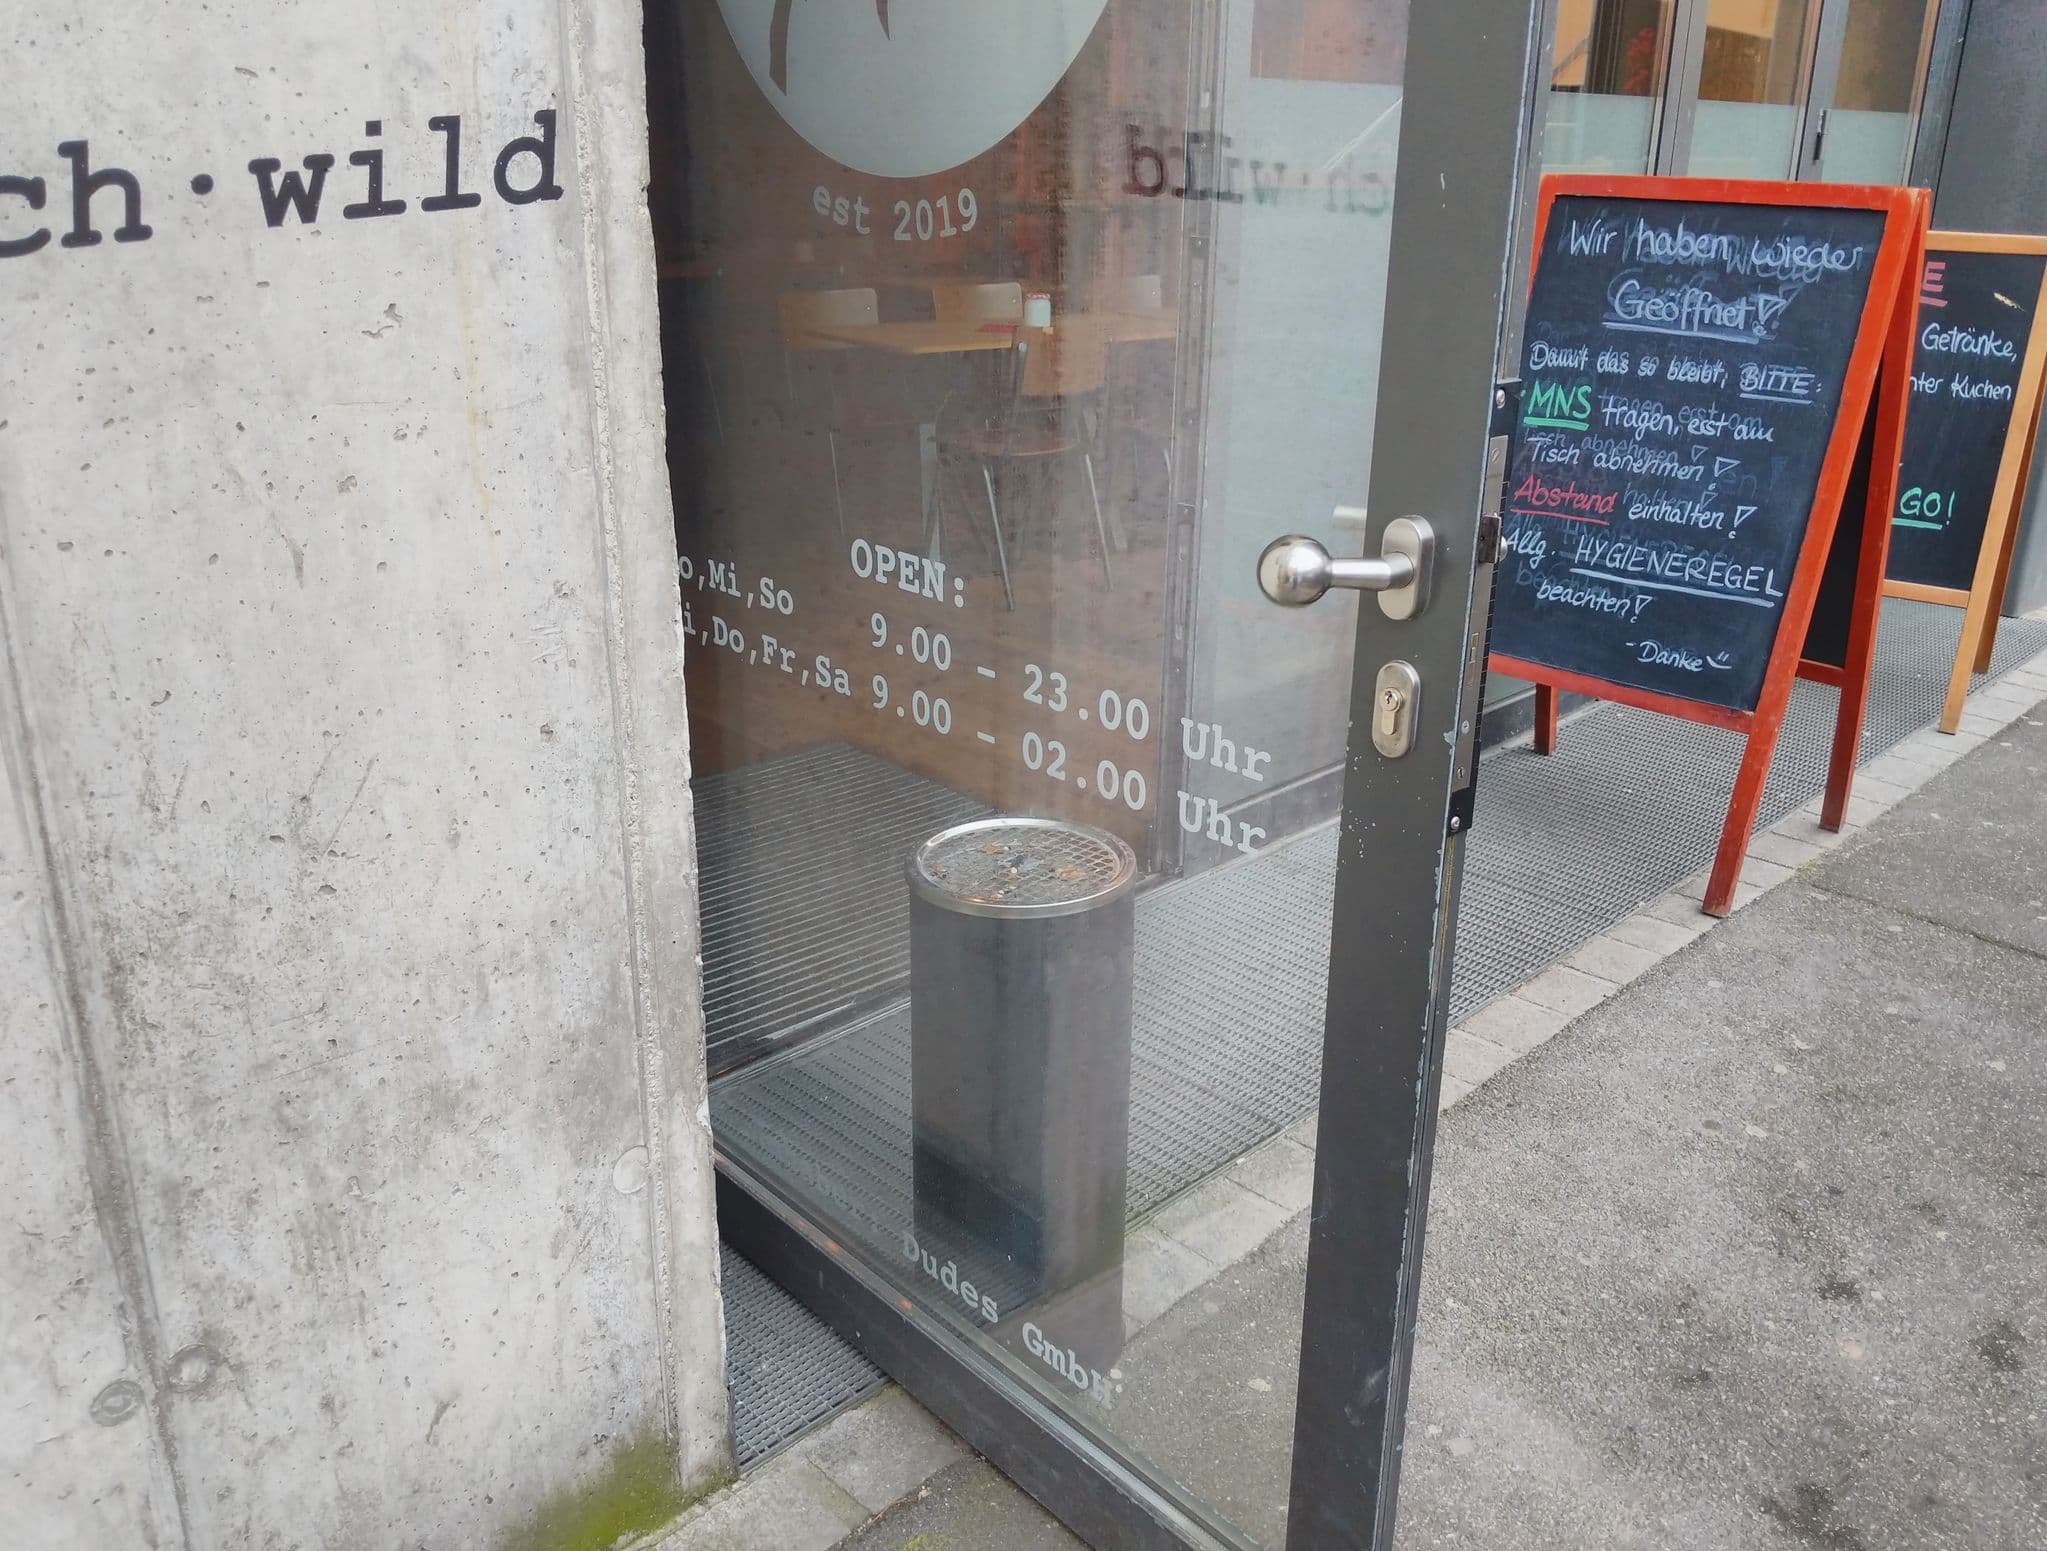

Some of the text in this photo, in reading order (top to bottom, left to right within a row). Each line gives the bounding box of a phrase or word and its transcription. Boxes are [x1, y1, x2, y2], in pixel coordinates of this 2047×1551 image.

[812, 185, 978, 241] est 2019
[1569, 216, 1864, 272] Wir haben wieder
[1529, 340, 1589, 372] Damit
[1596, 345, 1630, 375] das
[1637, 355, 1660, 378] so
[1921, 322, 2018, 362] Getränke,
[1527, 379, 1592, 419] MNS
[1601, 395, 1681, 442] tragen,
[1950, 372, 2012, 401] Kuchen
[1526, 437, 1580, 465] Tisch
[1513, 473, 1619, 514] Abstand
[1899, 486, 1956, 526] GO!
[850, 538, 966, 609] OPEN:
[1573, 534, 1784, 598] HYGIENEREGEL
[870, 612, 952, 673] 9.00
[1022, 664, 1150, 741] 23.00
[1179, 716, 1272, 782] Uhr
[871, 674, 952, 735] 9.00
[1021, 731, 1147, 811] 02.00
[1175, 790, 1267, 856] Uhr
[901, 1231, 999, 1324] Dudes
